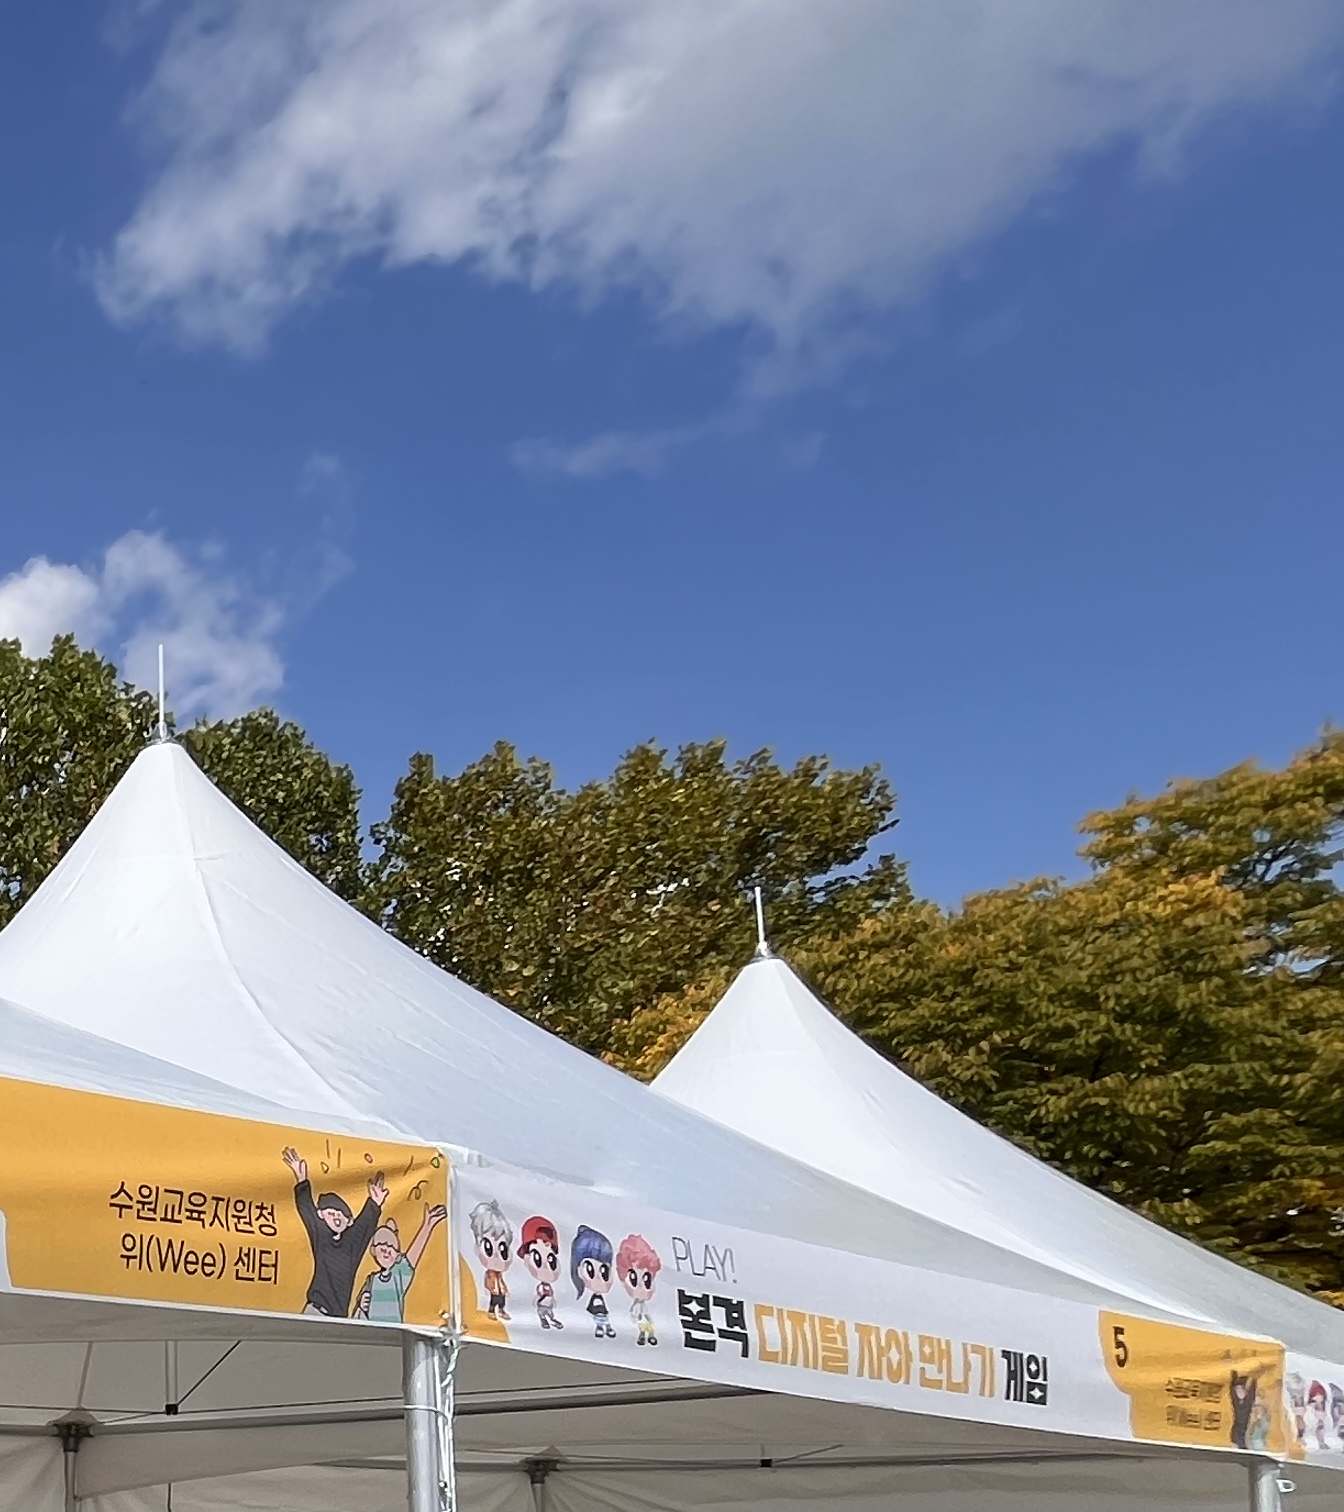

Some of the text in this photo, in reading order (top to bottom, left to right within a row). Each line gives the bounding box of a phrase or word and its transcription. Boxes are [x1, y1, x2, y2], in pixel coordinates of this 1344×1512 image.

[108, 1179, 279, 1238] 수원교육지원청
[119, 1232, 280, 1286] 위(Wee) 센터
[671, 1236, 739, 1285] PLAY!
[675, 1288, 1049, 1406] 본격 디지털 자아 만나기 게임
[1111, 1326, 1129, 1369] 5
